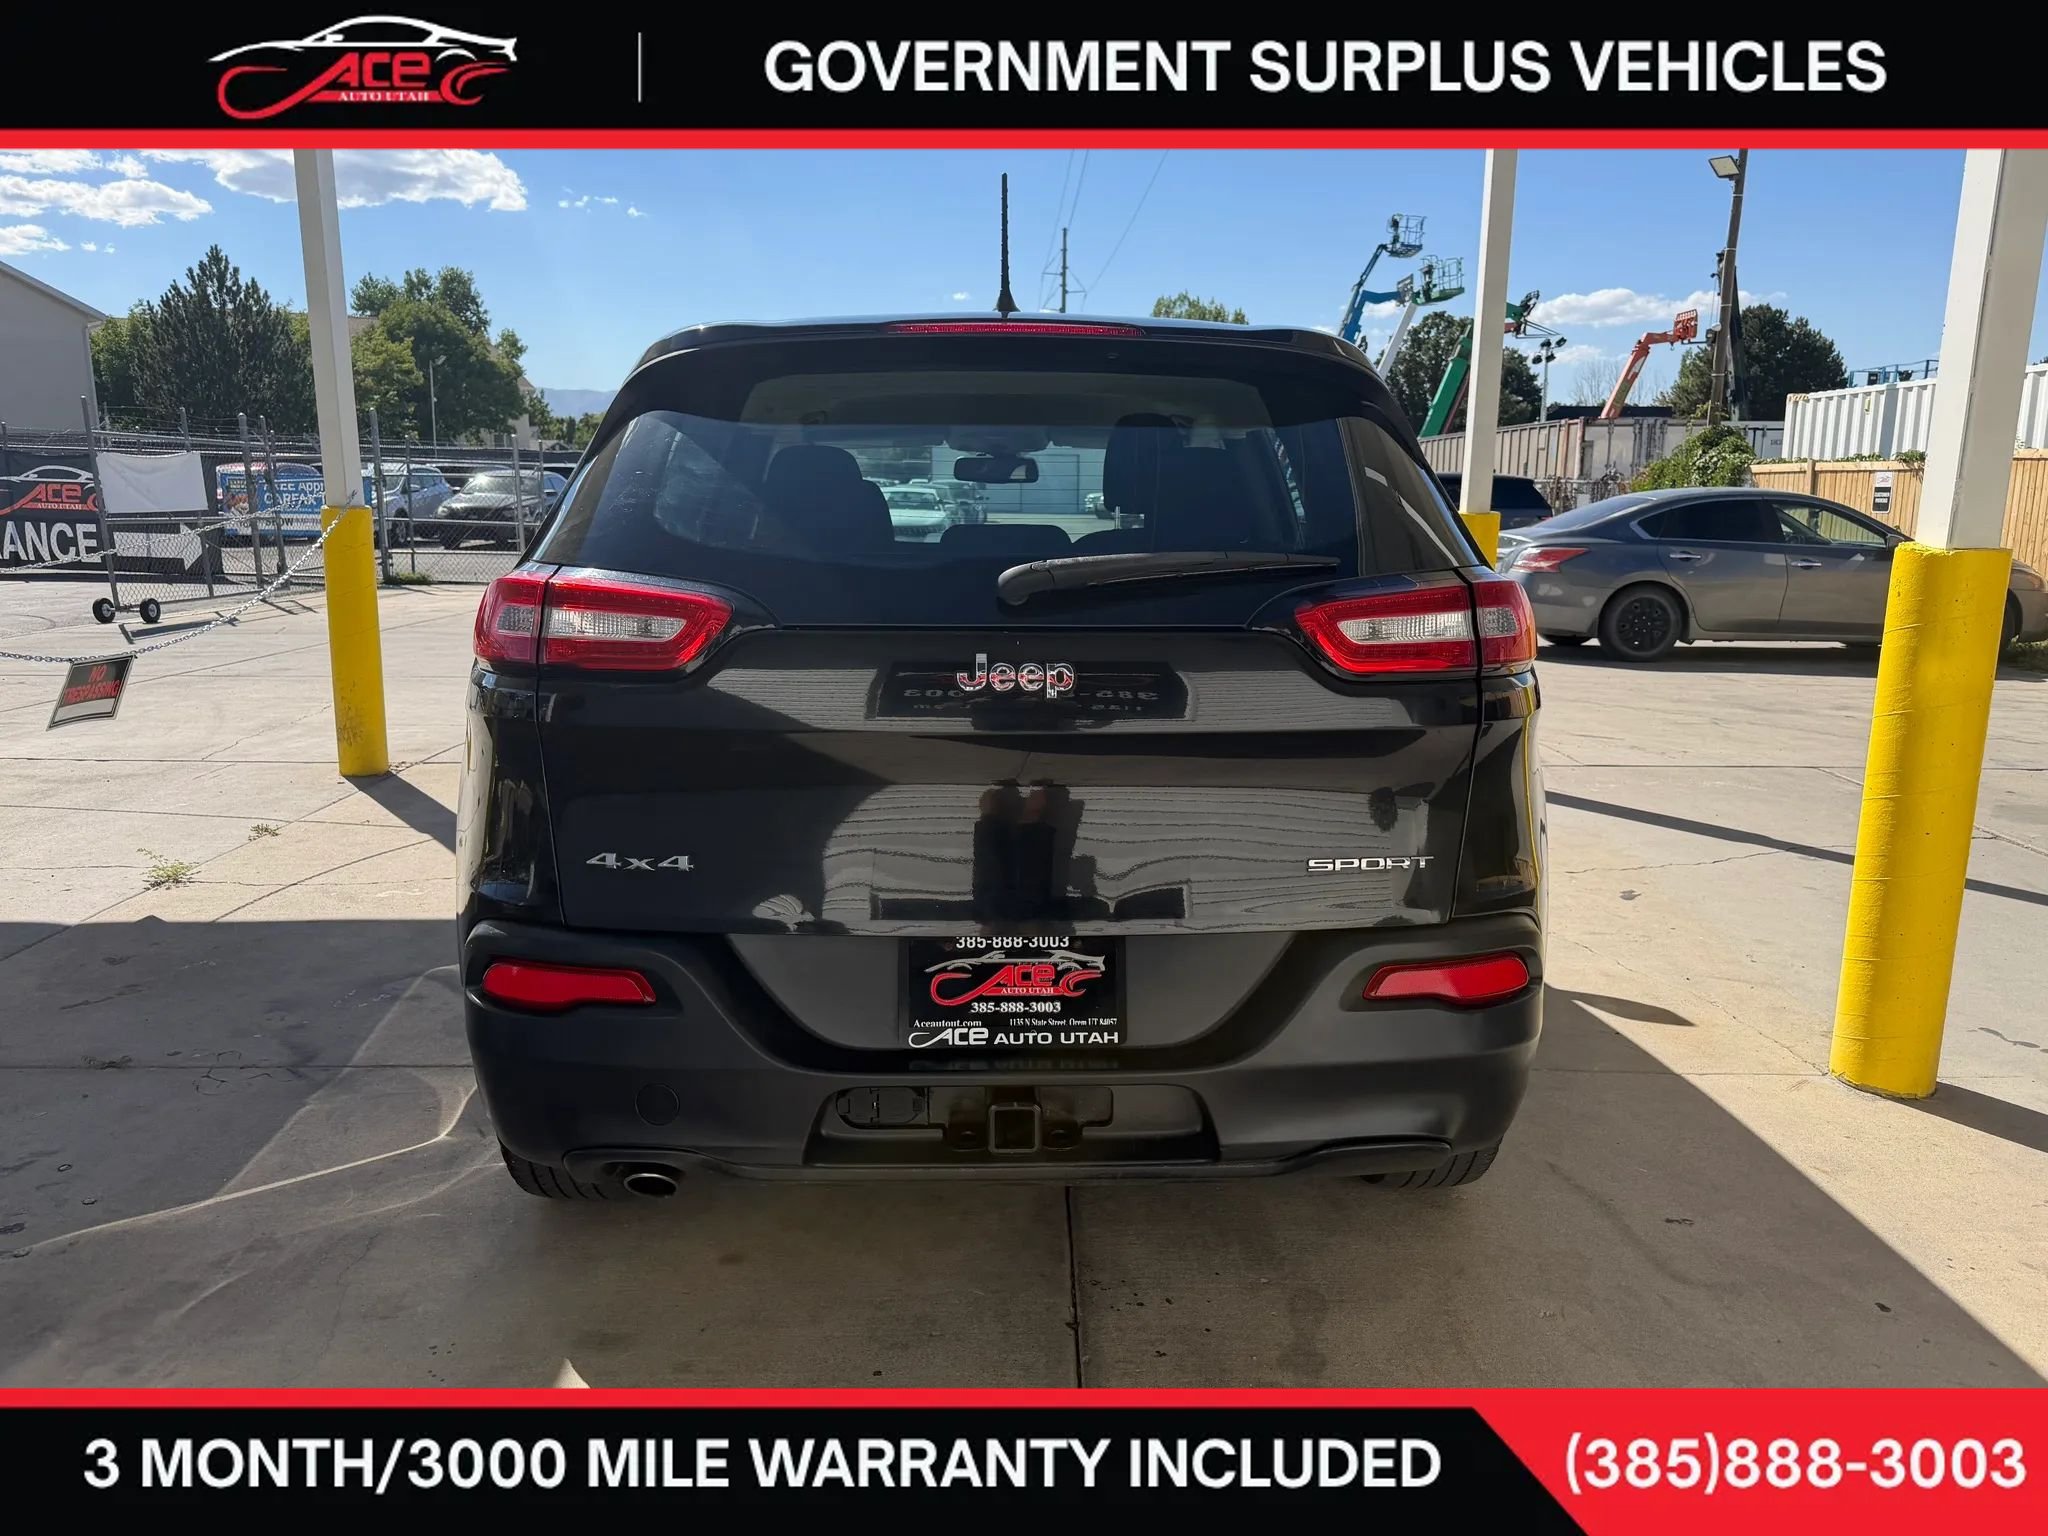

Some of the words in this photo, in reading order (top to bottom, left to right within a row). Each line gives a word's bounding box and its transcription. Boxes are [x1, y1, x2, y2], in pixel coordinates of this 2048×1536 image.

[264, 482, 297, 491] EE
[0, 520, 102, 562] ANCE
[956, 653, 1075, 699] Jeep
[586, 852, 694, 871] 4x4
[1307, 856, 1435, 872] SPORT
[956, 936, 1070, 949] 385-888-3003
[1001, 987, 1027, 995] AUTO
[1028, 987, 1054, 995] UTAH
[971, 1001, 1061, 1014] 385-888-3003
[994, 1031, 1053, 1045] AUTO
[1060, 1031, 1119, 1044] UTAH
